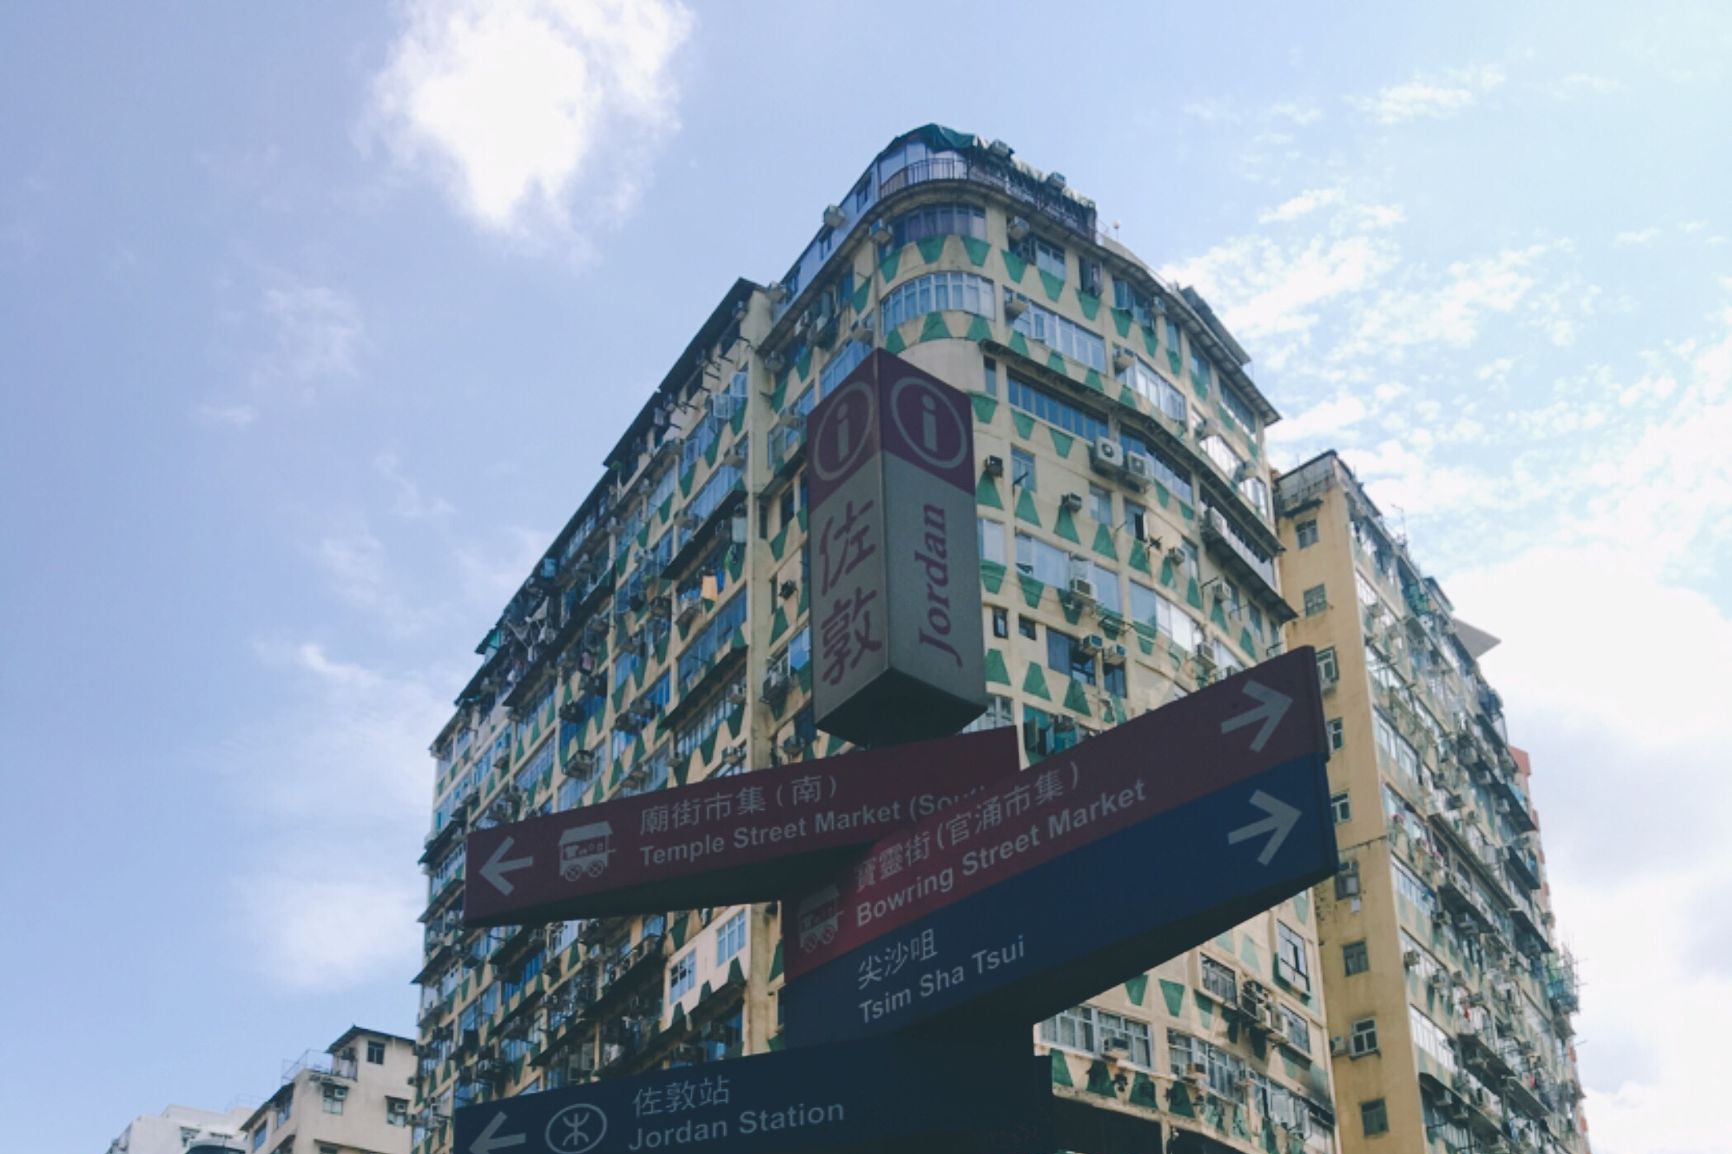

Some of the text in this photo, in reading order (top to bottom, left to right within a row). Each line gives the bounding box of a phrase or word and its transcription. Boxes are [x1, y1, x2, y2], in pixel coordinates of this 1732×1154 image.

[819, 500, 883, 686] 佐敦
[914, 503, 963, 668] Jordan
[640, 834, 725, 868] Temple
[733, 820, 807, 850] Street
[815, 801, 901, 834] Market
[856, 779, 1147, 928] Bowring Street Market
[857, 928, 938, 989] 尖沙咀
[858, 935, 1026, 1024] Tsim Sha Tsui
[628, 1099, 845, 1152] Jordan Station
[632, 1074, 731, 1119] 佐敦站
